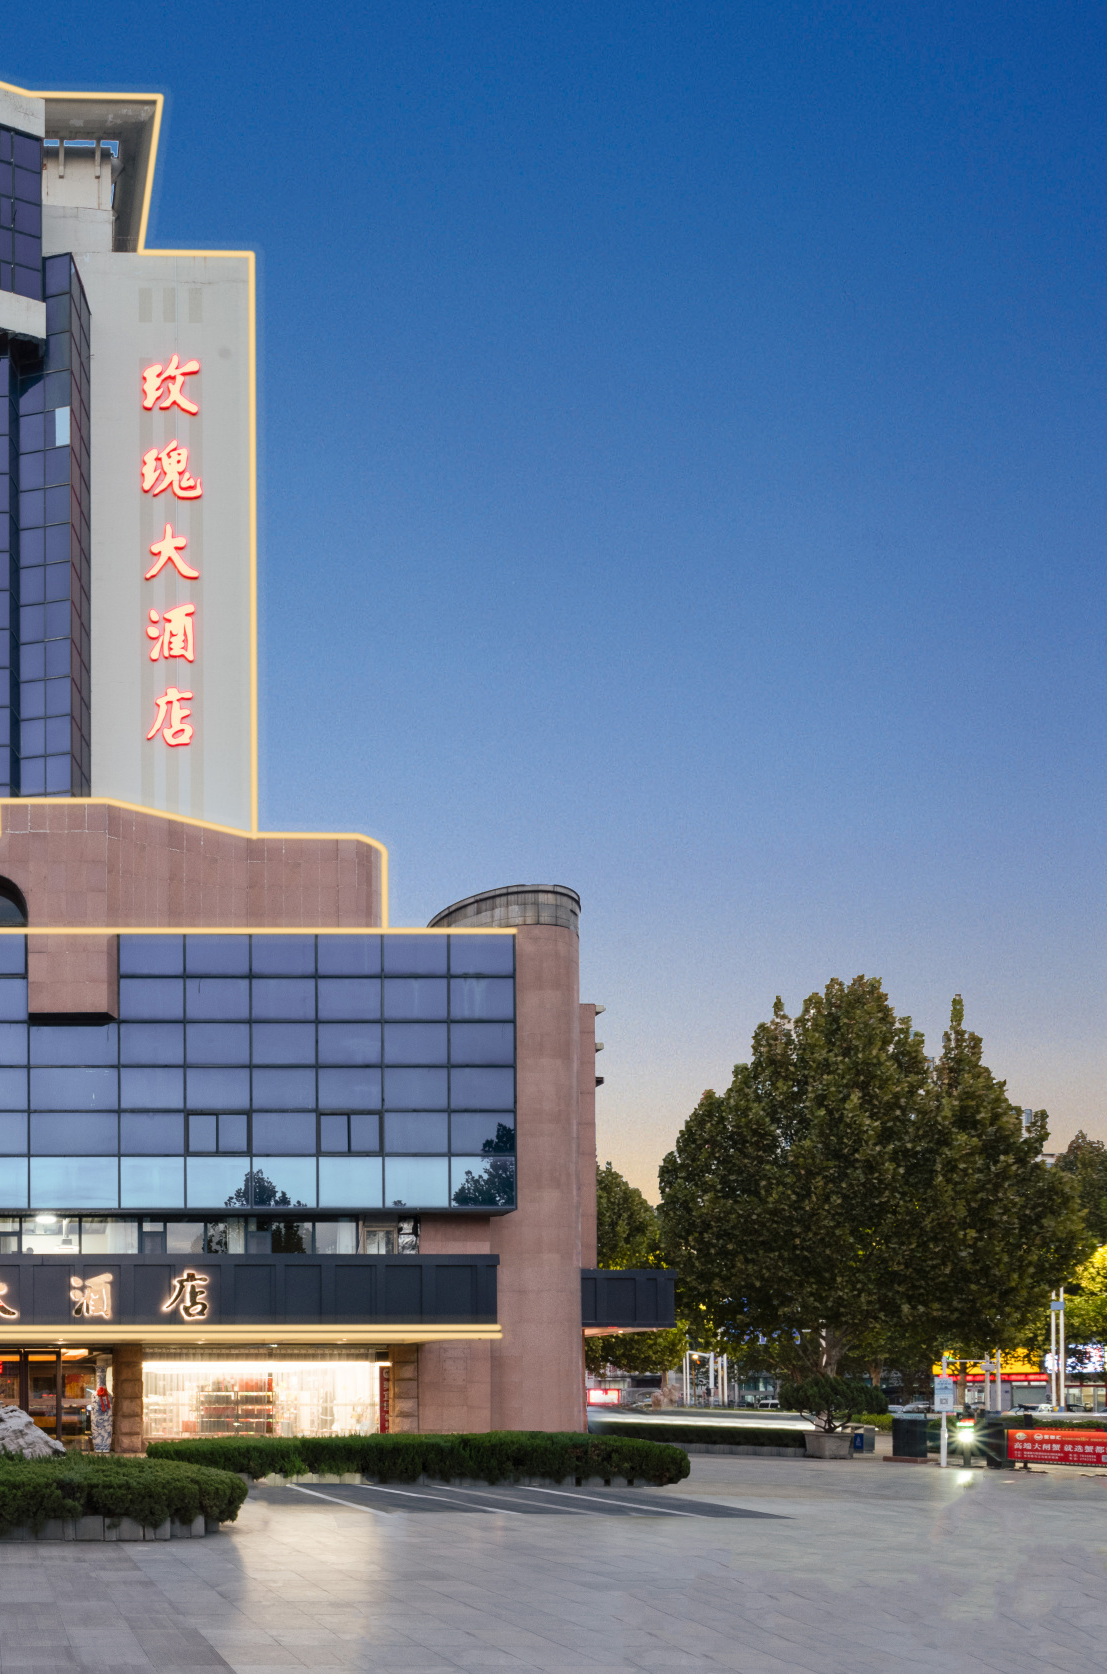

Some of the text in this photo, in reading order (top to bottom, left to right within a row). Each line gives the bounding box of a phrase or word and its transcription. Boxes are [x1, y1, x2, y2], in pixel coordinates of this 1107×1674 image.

[141, 354, 204, 747] 玫瑰大酒店
[1014, 1442, 1061, 1452] 高端大闸蟹
[1063, 1444, 1107, 1454] 就选蟹都
